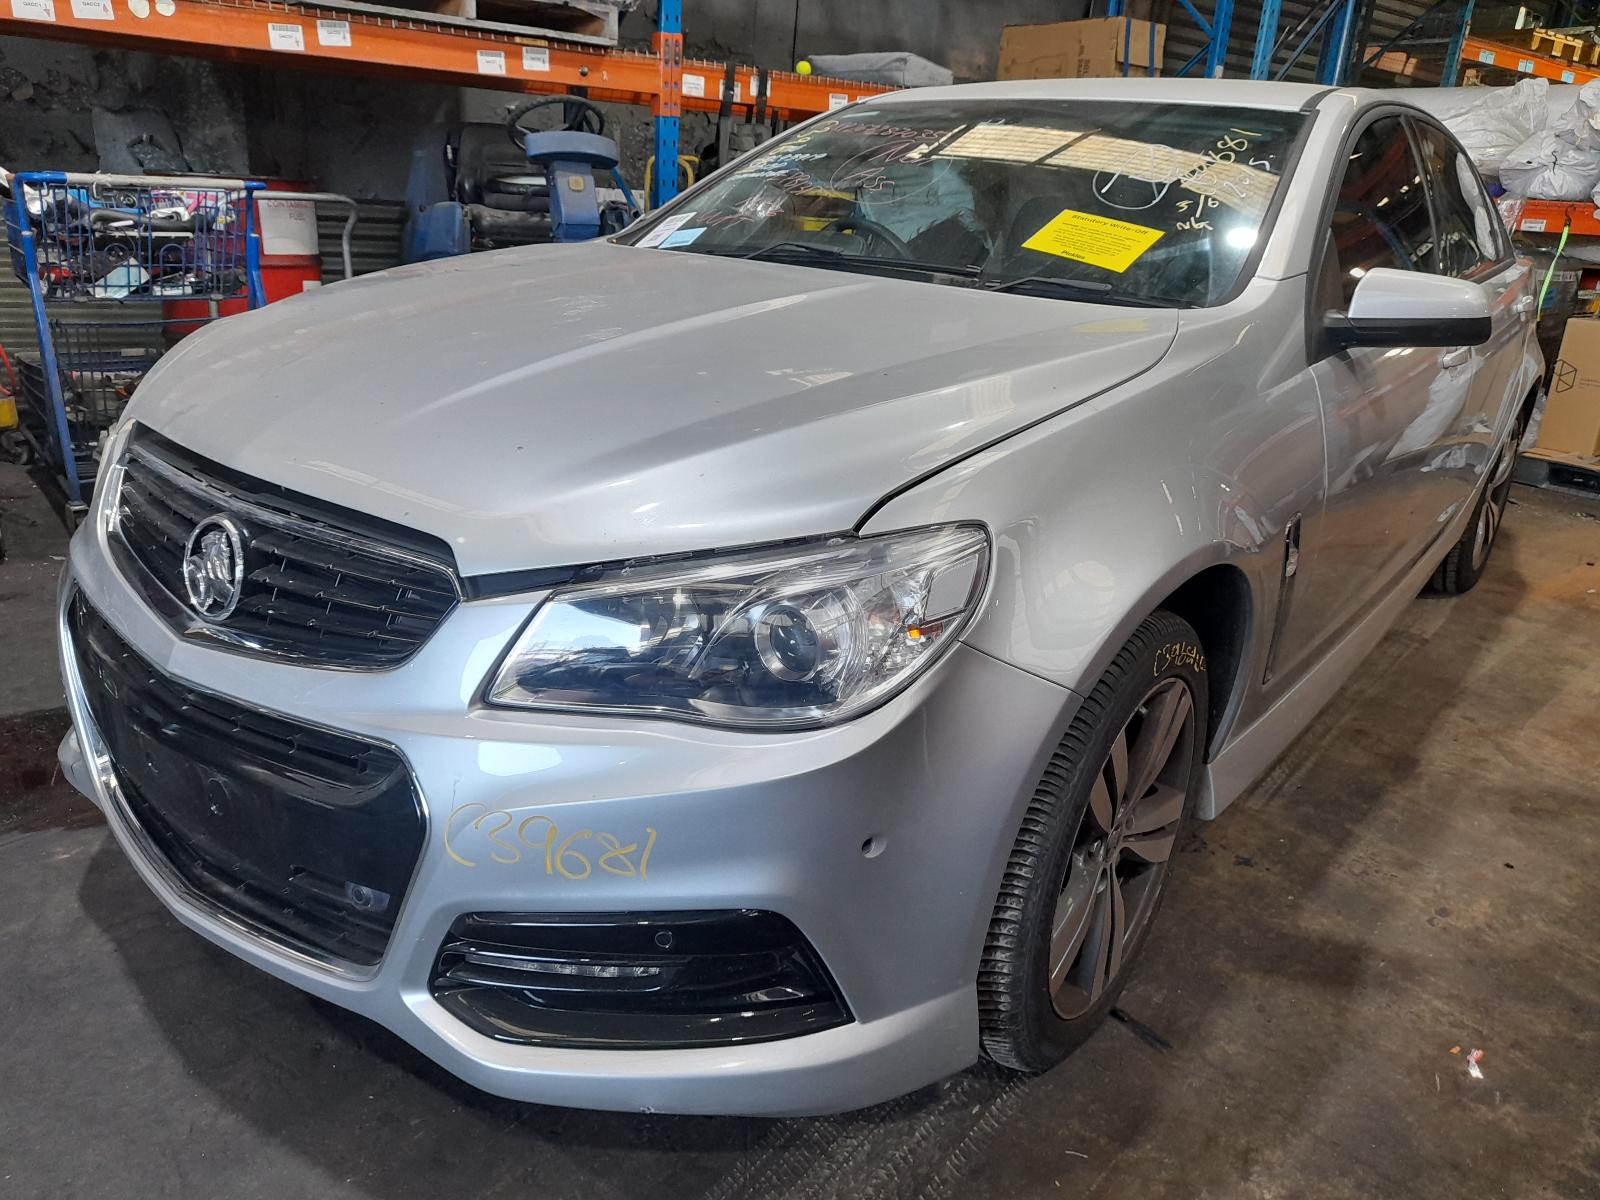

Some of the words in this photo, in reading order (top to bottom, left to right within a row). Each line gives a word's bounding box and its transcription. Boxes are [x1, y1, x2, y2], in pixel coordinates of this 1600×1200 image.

[1071, 214, 1108, 226] Statutory
[1110, 222, 1149, 236] Write-Off
[1061, 249, 1086, 260] Pickles
